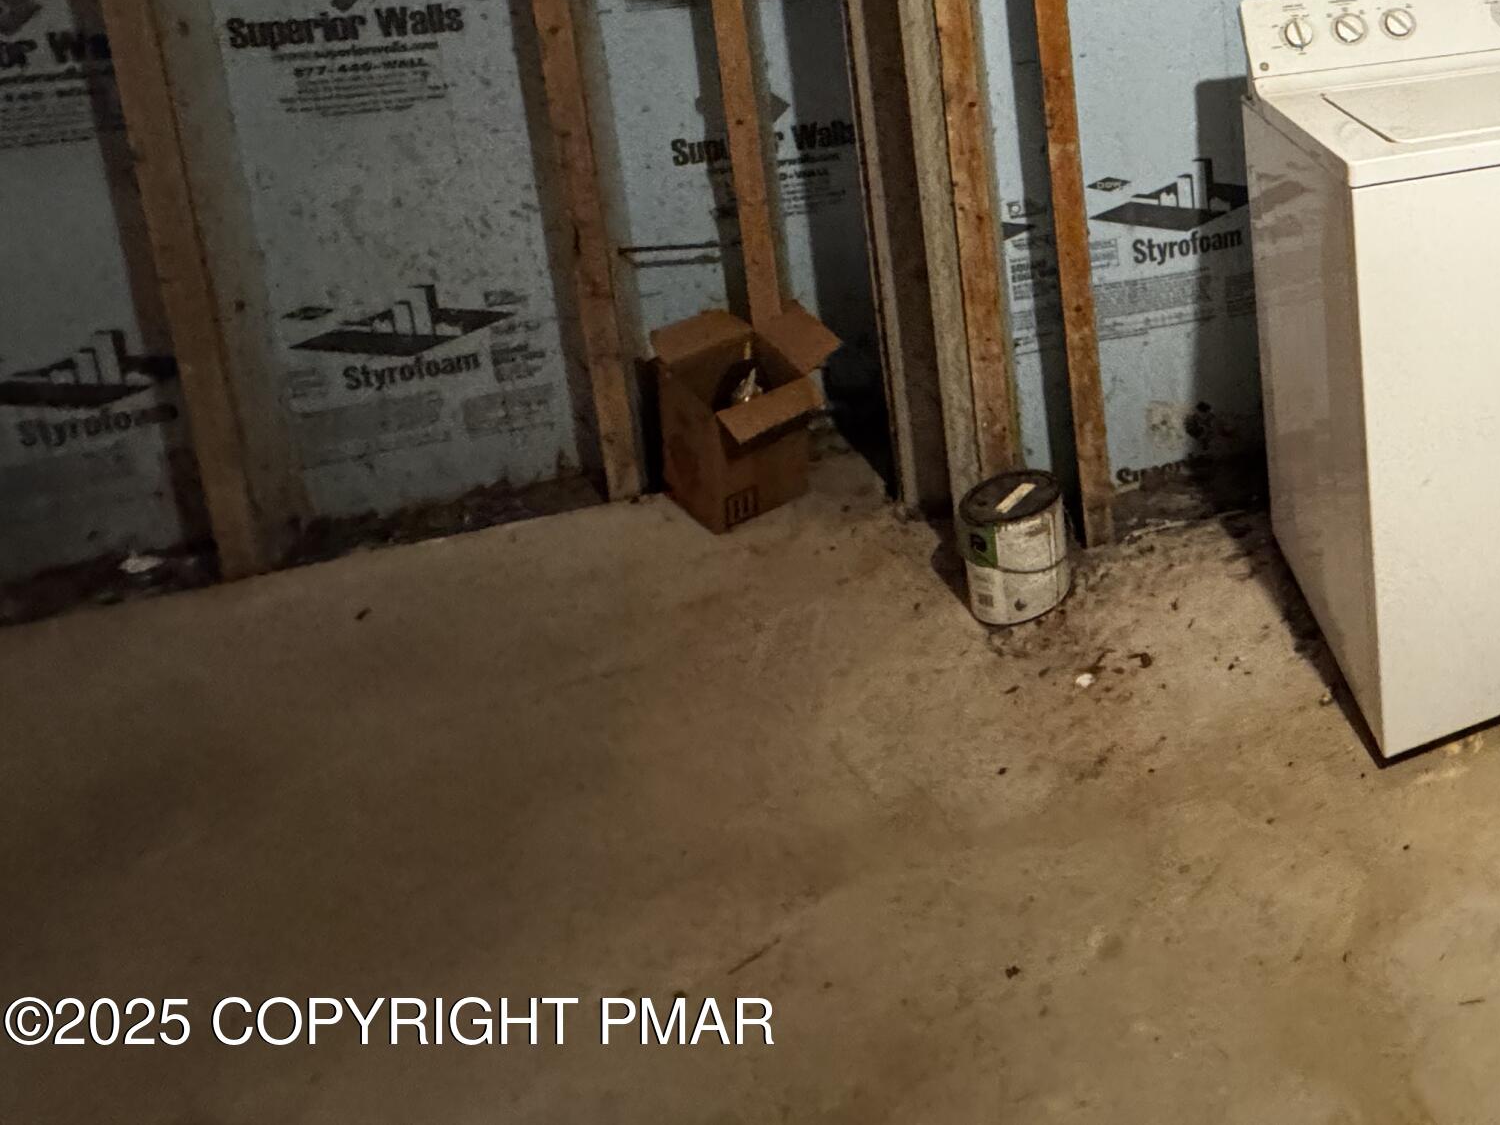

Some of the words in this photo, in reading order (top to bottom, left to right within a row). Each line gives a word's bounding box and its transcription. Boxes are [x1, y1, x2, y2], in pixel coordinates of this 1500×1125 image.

[226, 10, 367, 52] Superior
[375, 4, 465, 37] Walls
[1132, 228, 1243, 265] Styrofoam
[342, 351, 481, 392] Styrofoam
